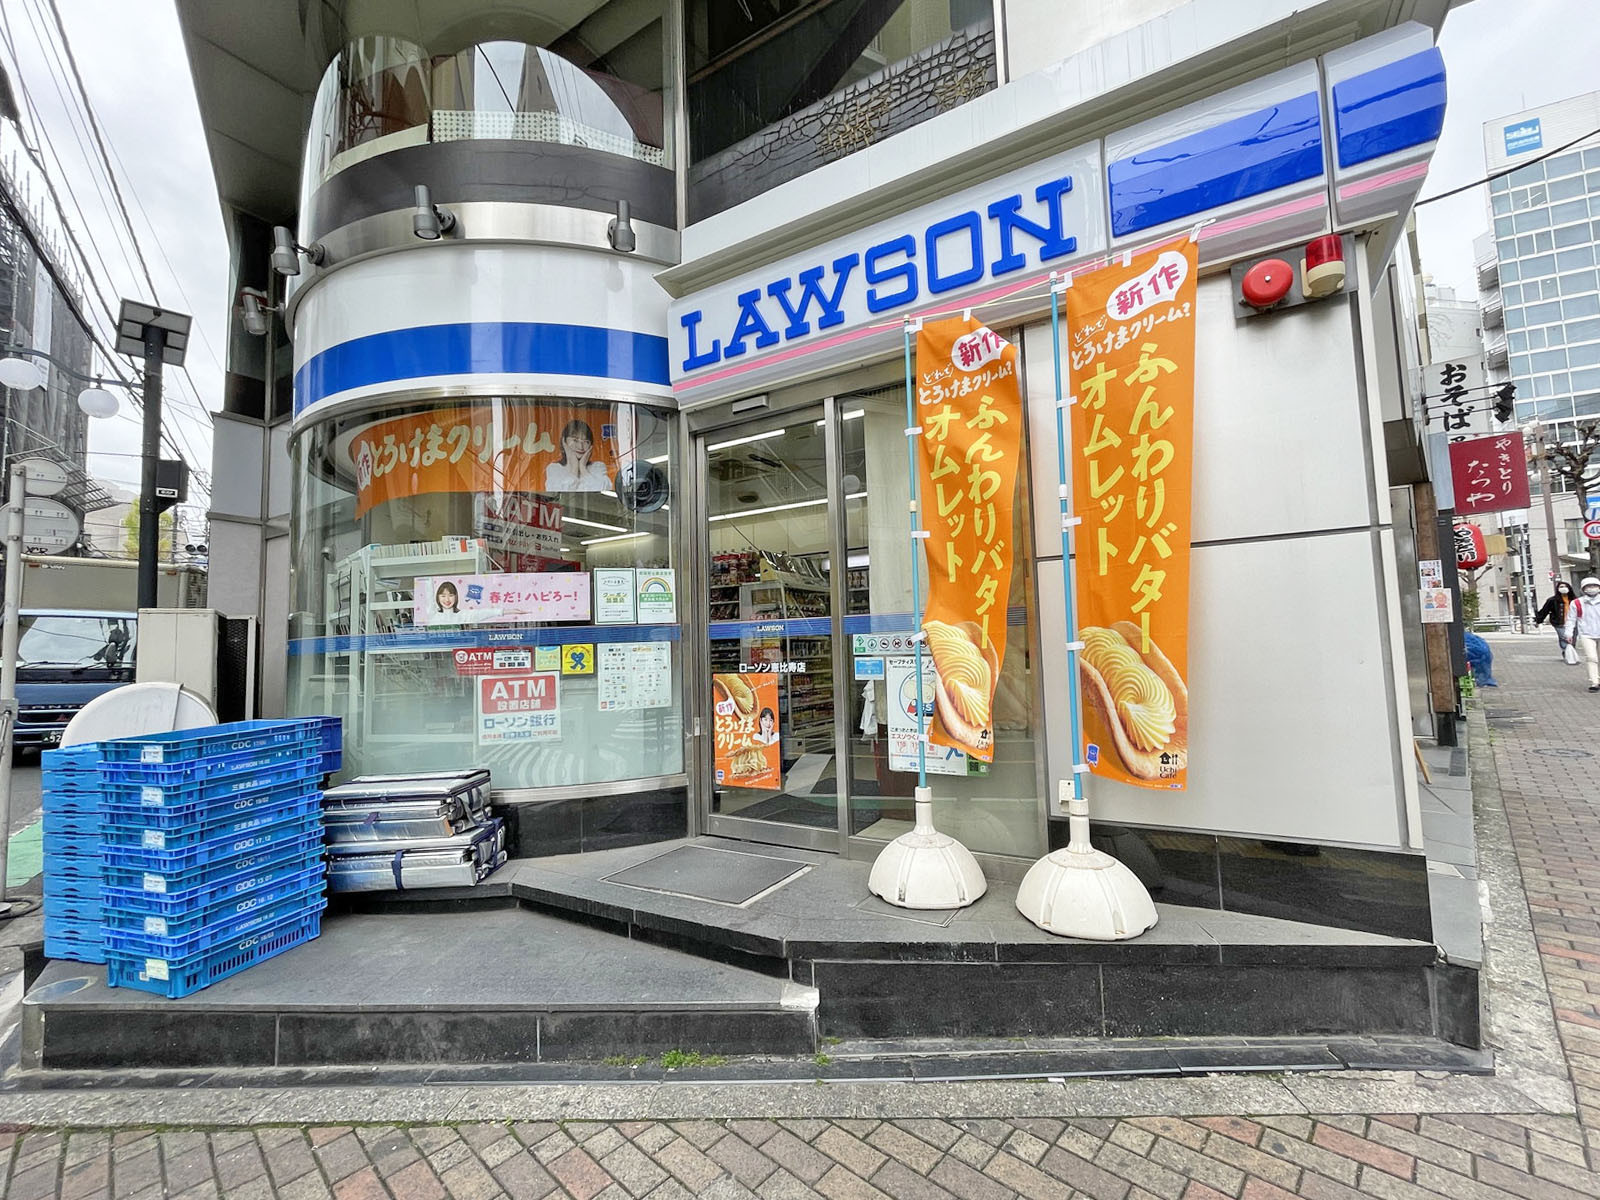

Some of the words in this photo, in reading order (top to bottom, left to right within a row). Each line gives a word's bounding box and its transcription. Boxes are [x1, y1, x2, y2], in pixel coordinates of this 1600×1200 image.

[681, 175, 1078, 372] LAWSON
[1115, 263, 1180, 315] 新作
[1440, 364, 1475, 442] おそば
[1081, 361, 1125, 577] オムレット
[1494, 438, 1512, 495] やきとり
[925, 405, 965, 583] オムレット
[1124, 342, 1178, 655] ふんわりバター
[506, 499, 561, 529] ATM
[966, 395, 1008, 649] ふんわりバター
[488, 633, 524, 641] LAWSON
[468, 652, 492, 661] ATM
[739, 662, 806, 673] ローソン恵比寿店
[490, 679, 546, 700] ATM
[484, 713, 556, 729] ローソン銀行
[231, 741, 251, 750] CDC
[234, 799, 254, 809] CDC
[234, 838, 254, 851] CDC
[236, 858, 255, 869] CDC
[236, 879, 256, 892] CDC
[237, 898, 257, 912] CDC
[239, 936, 258, 950] CDC
